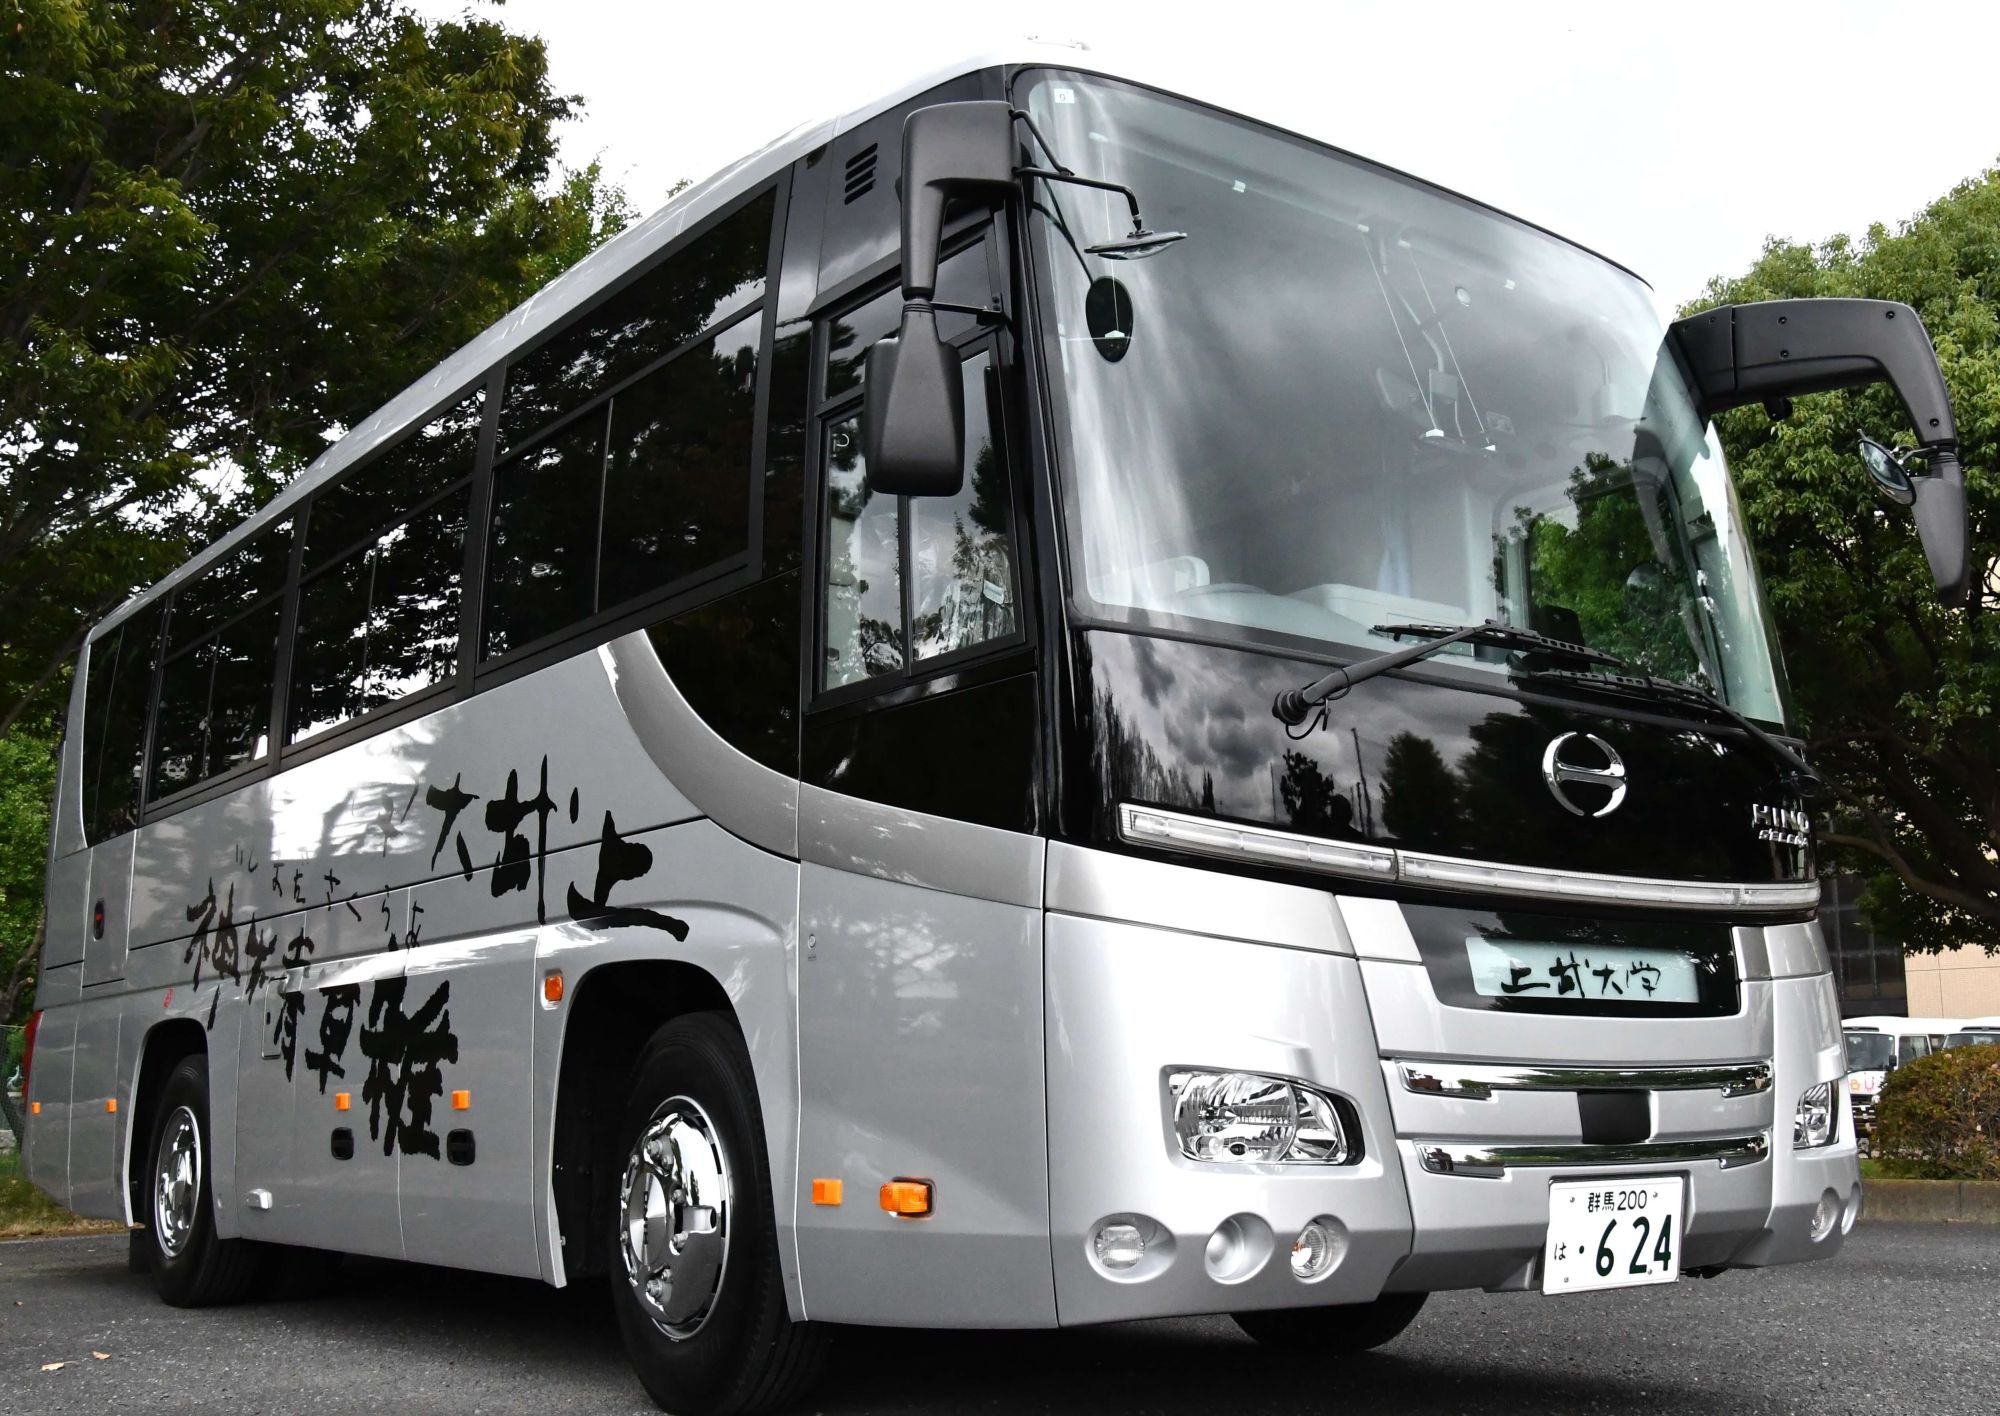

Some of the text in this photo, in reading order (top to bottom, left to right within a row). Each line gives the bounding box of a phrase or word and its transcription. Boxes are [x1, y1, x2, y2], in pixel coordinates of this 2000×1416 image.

[1752, 803, 1810, 834] HINO
[1500, 951, 1661, 999] 上武大学
[1554, 1241, 1567, 1261] は
